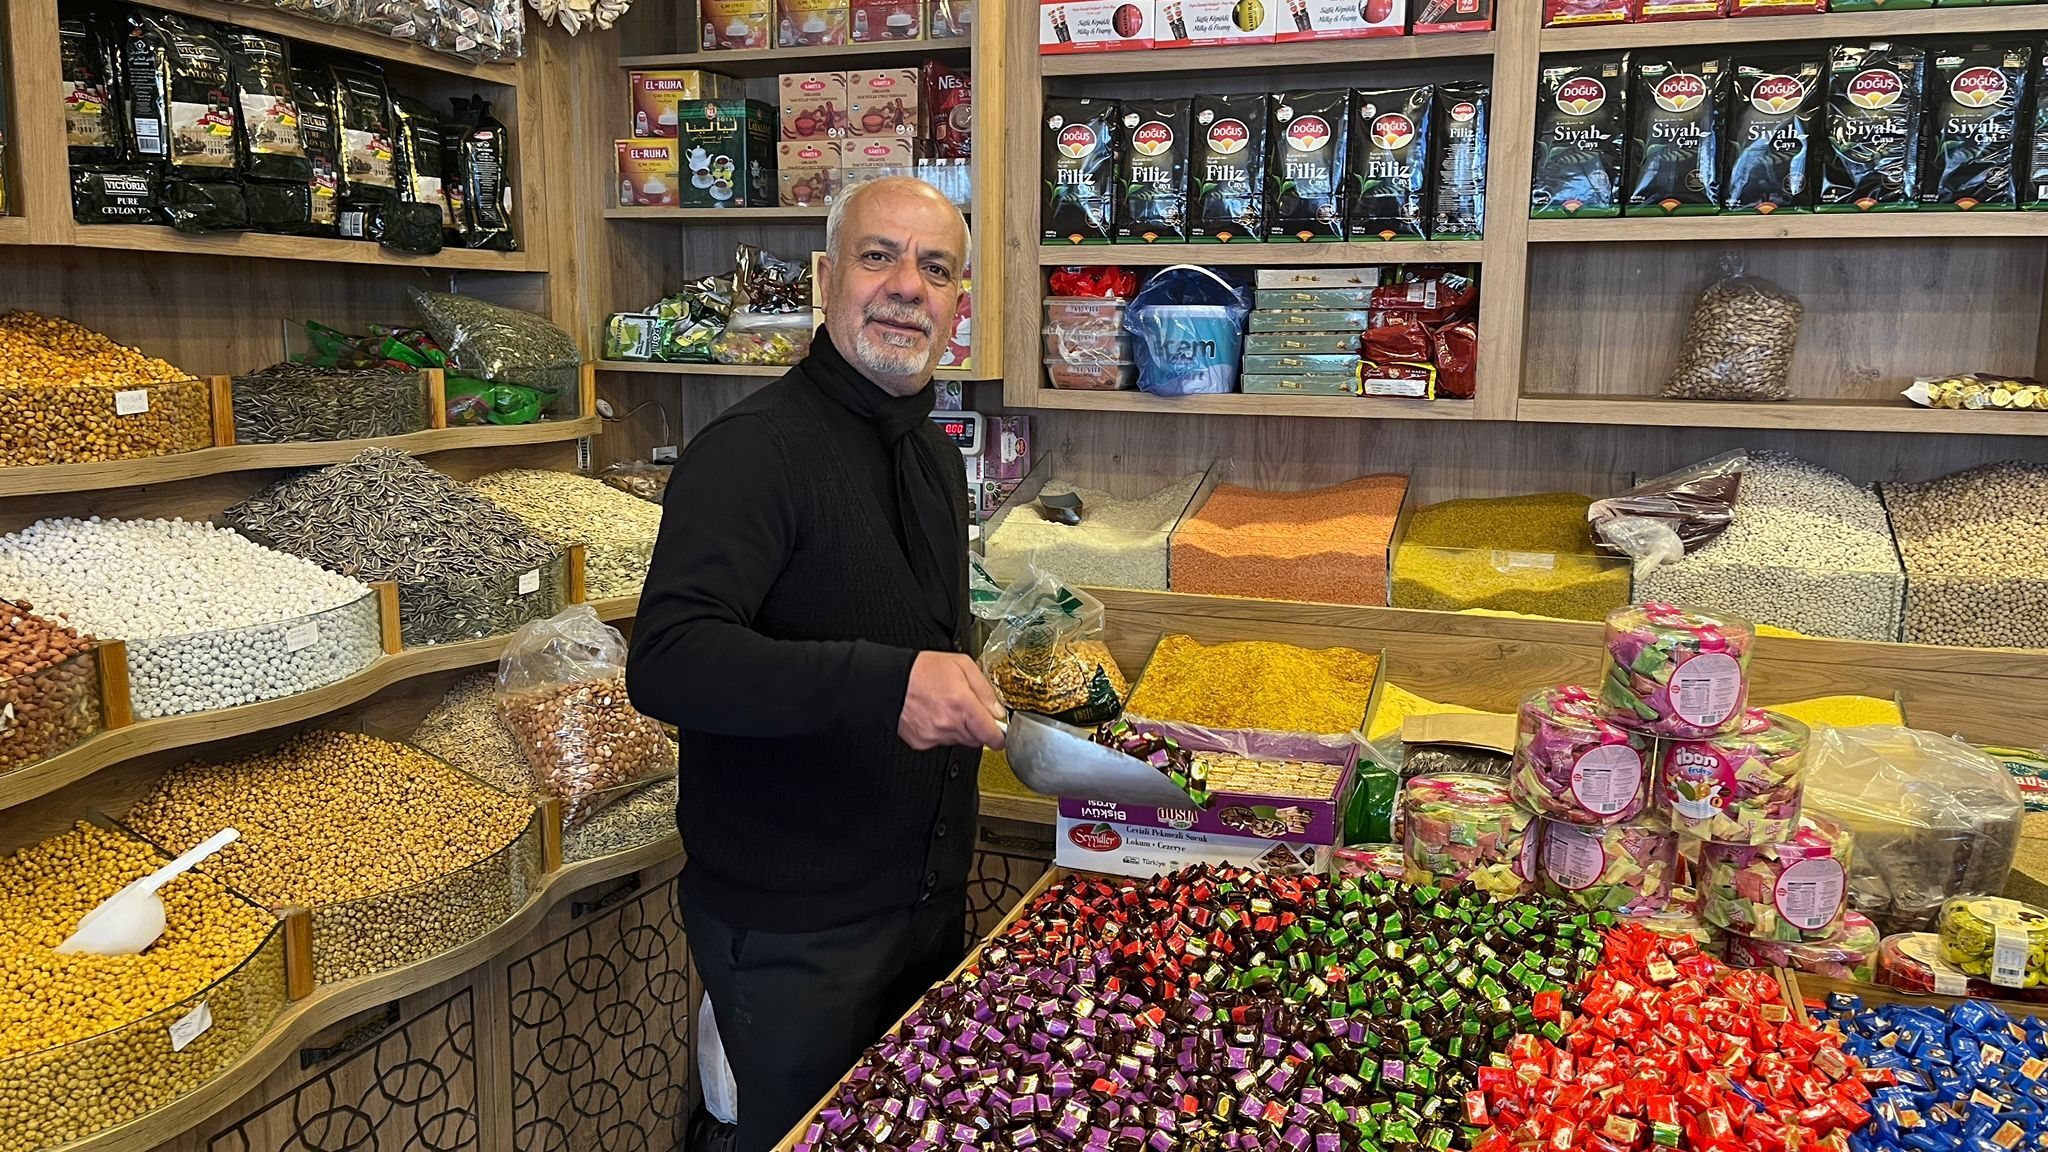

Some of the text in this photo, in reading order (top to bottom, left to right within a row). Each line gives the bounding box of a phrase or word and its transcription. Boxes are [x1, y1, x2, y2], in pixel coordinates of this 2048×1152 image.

[645, 80, 683, 90] EL-RUHA
[1662, 80, 1698, 95] DOĞUŞ
[1856, 77, 1894, 90] DOĞUŞ
[1960, 74, 1999, 88] DOĞUŞ
[1564, 83, 1598, 96] DOĞUŞ
[1759, 82, 1796, 96] DOĞUŞ
[1213, 123, 1243, 137] DOĞUŞ
[1293, 121, 1324, 134] DOĞUŞ
[1376, 119, 1408, 133] DOĞUŞ
[1449, 128, 1475, 138] Filiz
[1651, 121, 1701, 142] Siyah
[1846, 119, 1898, 140] Siyah
[1947, 118, 2001, 139] Siyah
[1062, 130, 1091, 141] DOĞUŞ
[1139, 127, 1167, 140] DOĞUŞ
[1553, 126, 1601, 145] Siyah
[1747, 123, 1798, 145] Siyah
[1871, 134, 1894, 145] Çayı
[1974, 133, 1998, 145] Çayı
[1577, 139, 1598, 151] Çayı
[1676, 137, 1698, 149] Çayı
[1773, 140, 1795, 151] Çayı
[630, 149, 668, 159] EL-RUHA
[1057, 168, 1096, 185] Filiz
[1131, 166, 1172, 183] Filiz
[1205, 165, 1247, 181] Filiz
[1285, 162, 1327, 180] Filiz
[1367, 161, 1410, 179] Filiz
[105, 181, 148, 191] VICTORIA
[117, 197, 139, 205] PURE
[102, 206, 136, 215] CEYLON
[1675, 746, 1719, 769] ibon
[1081, 807, 1127, 821] Bisküvi
[1126, 825, 1151, 836] Cevizli
[1151, 828, 1184, 840] Pekmezli
[1125, 837, 1186, 853] Lokum Cezerye
[1142, 858, 1166, 867] Türkiye
